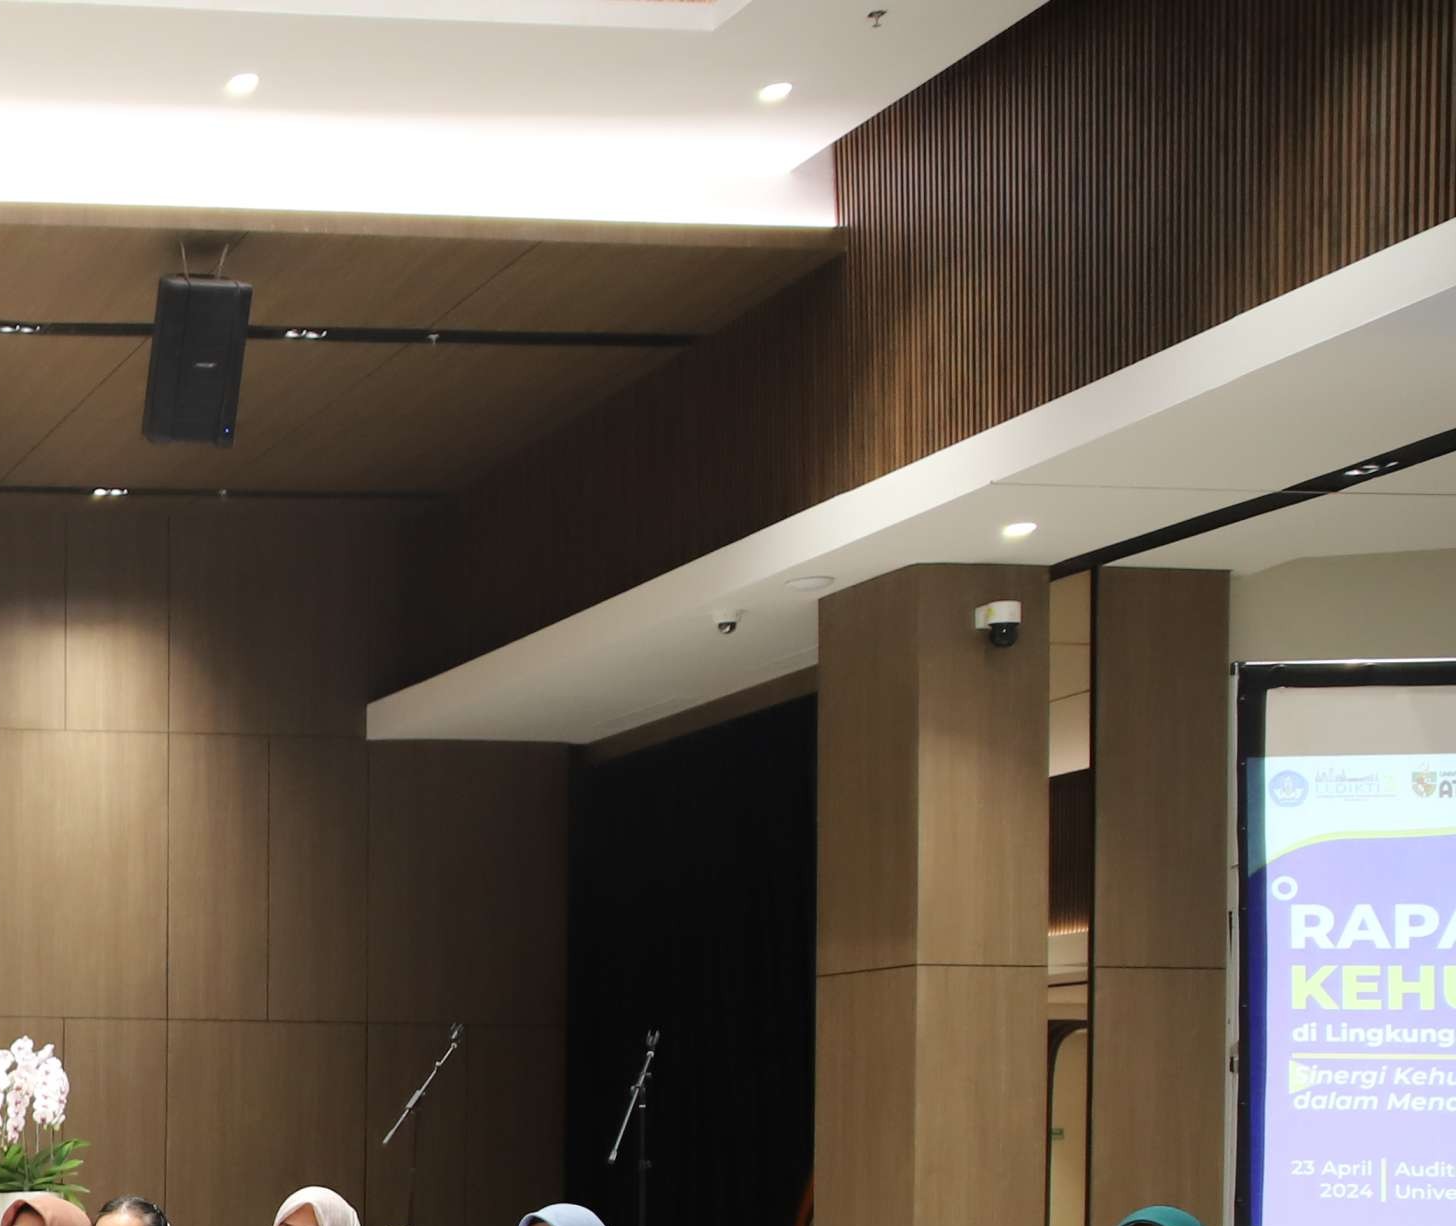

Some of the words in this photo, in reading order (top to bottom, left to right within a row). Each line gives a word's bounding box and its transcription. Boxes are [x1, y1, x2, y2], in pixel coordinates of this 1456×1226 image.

[1291, 965, 1456, 1010] KEH
[1292, 1022, 1318, 1042] di
[1294, 1064, 1388, 1089] Sinergi
[1293, 1091, 1378, 1110] dalam
[1291, 1160, 1316, 1175] 23
[1321, 1160, 1372, 1179] April
[1320, 1183, 1374, 1199] 2024
